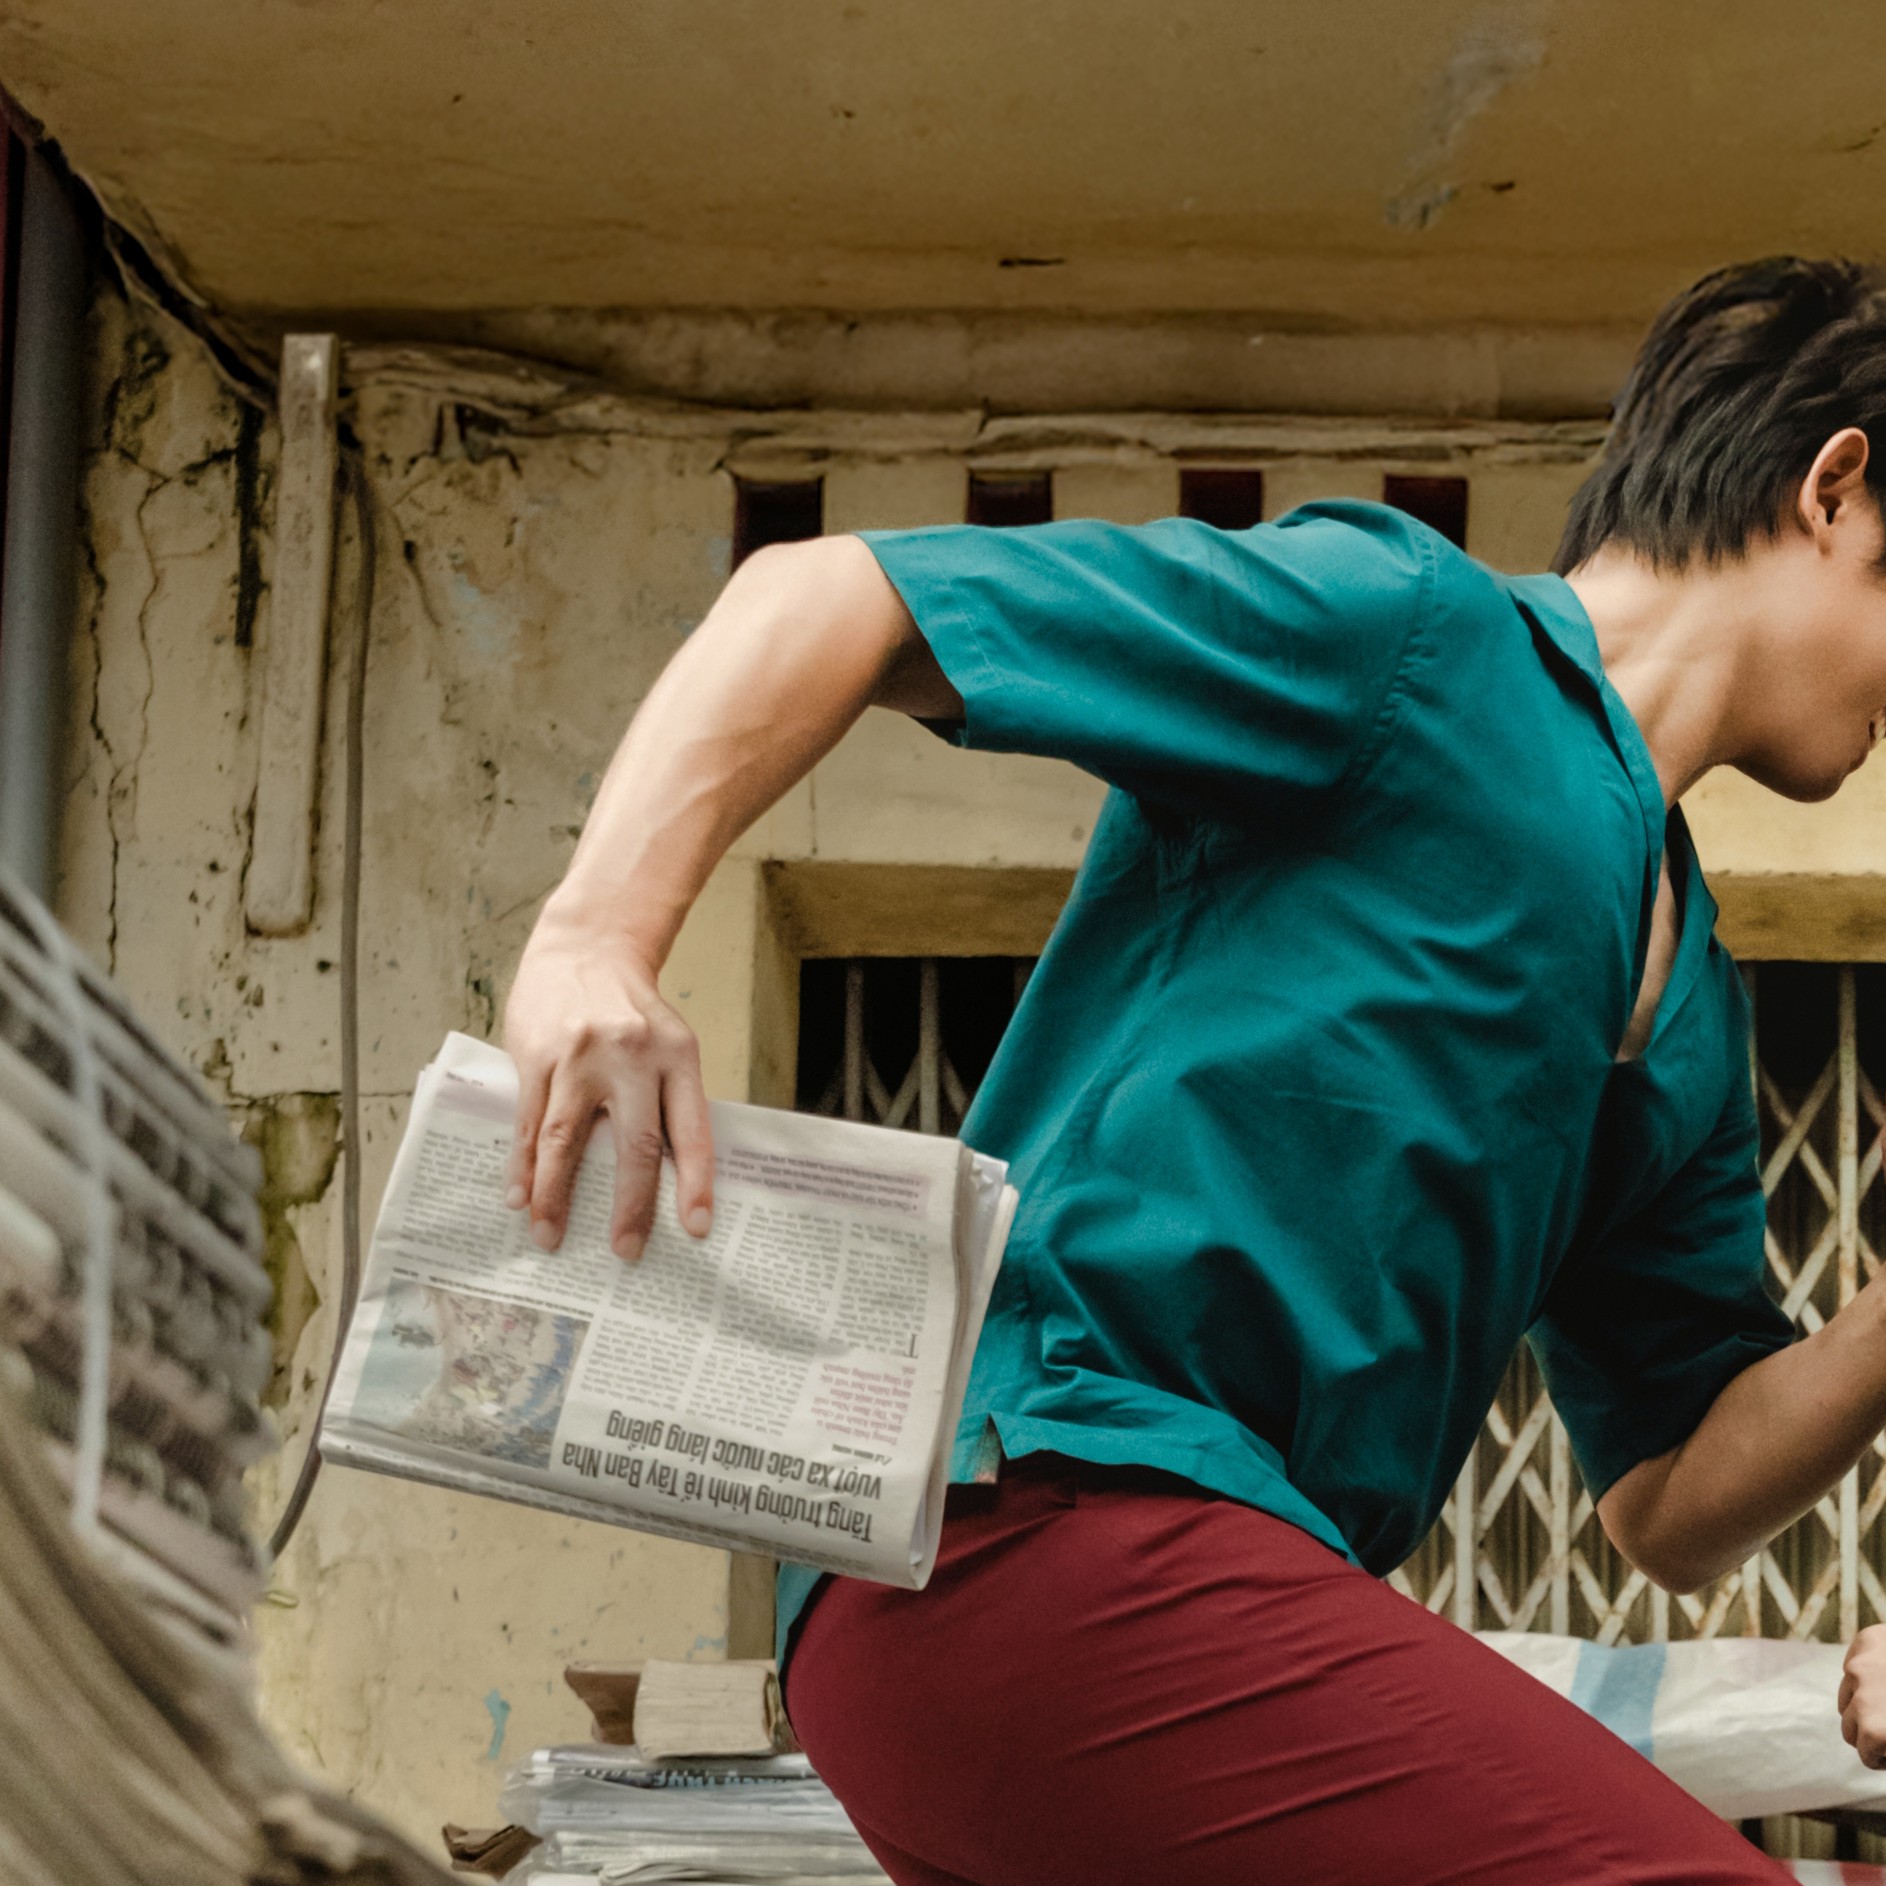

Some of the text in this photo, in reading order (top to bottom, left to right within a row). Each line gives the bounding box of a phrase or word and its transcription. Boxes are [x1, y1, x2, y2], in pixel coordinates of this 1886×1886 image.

[606, 1410, 664, 1451] giềng
[664, 1424, 711, 1462] láng
[713, 1439, 764, 1470] nước
[767, 1452, 805, 1483] các
[807, 1462, 829, 1487] xa
[836, 1465, 882, 1500] vượt
[562, 1442, 873, 1543] Tăng trưởng kinh tế Tây Ban Nha
